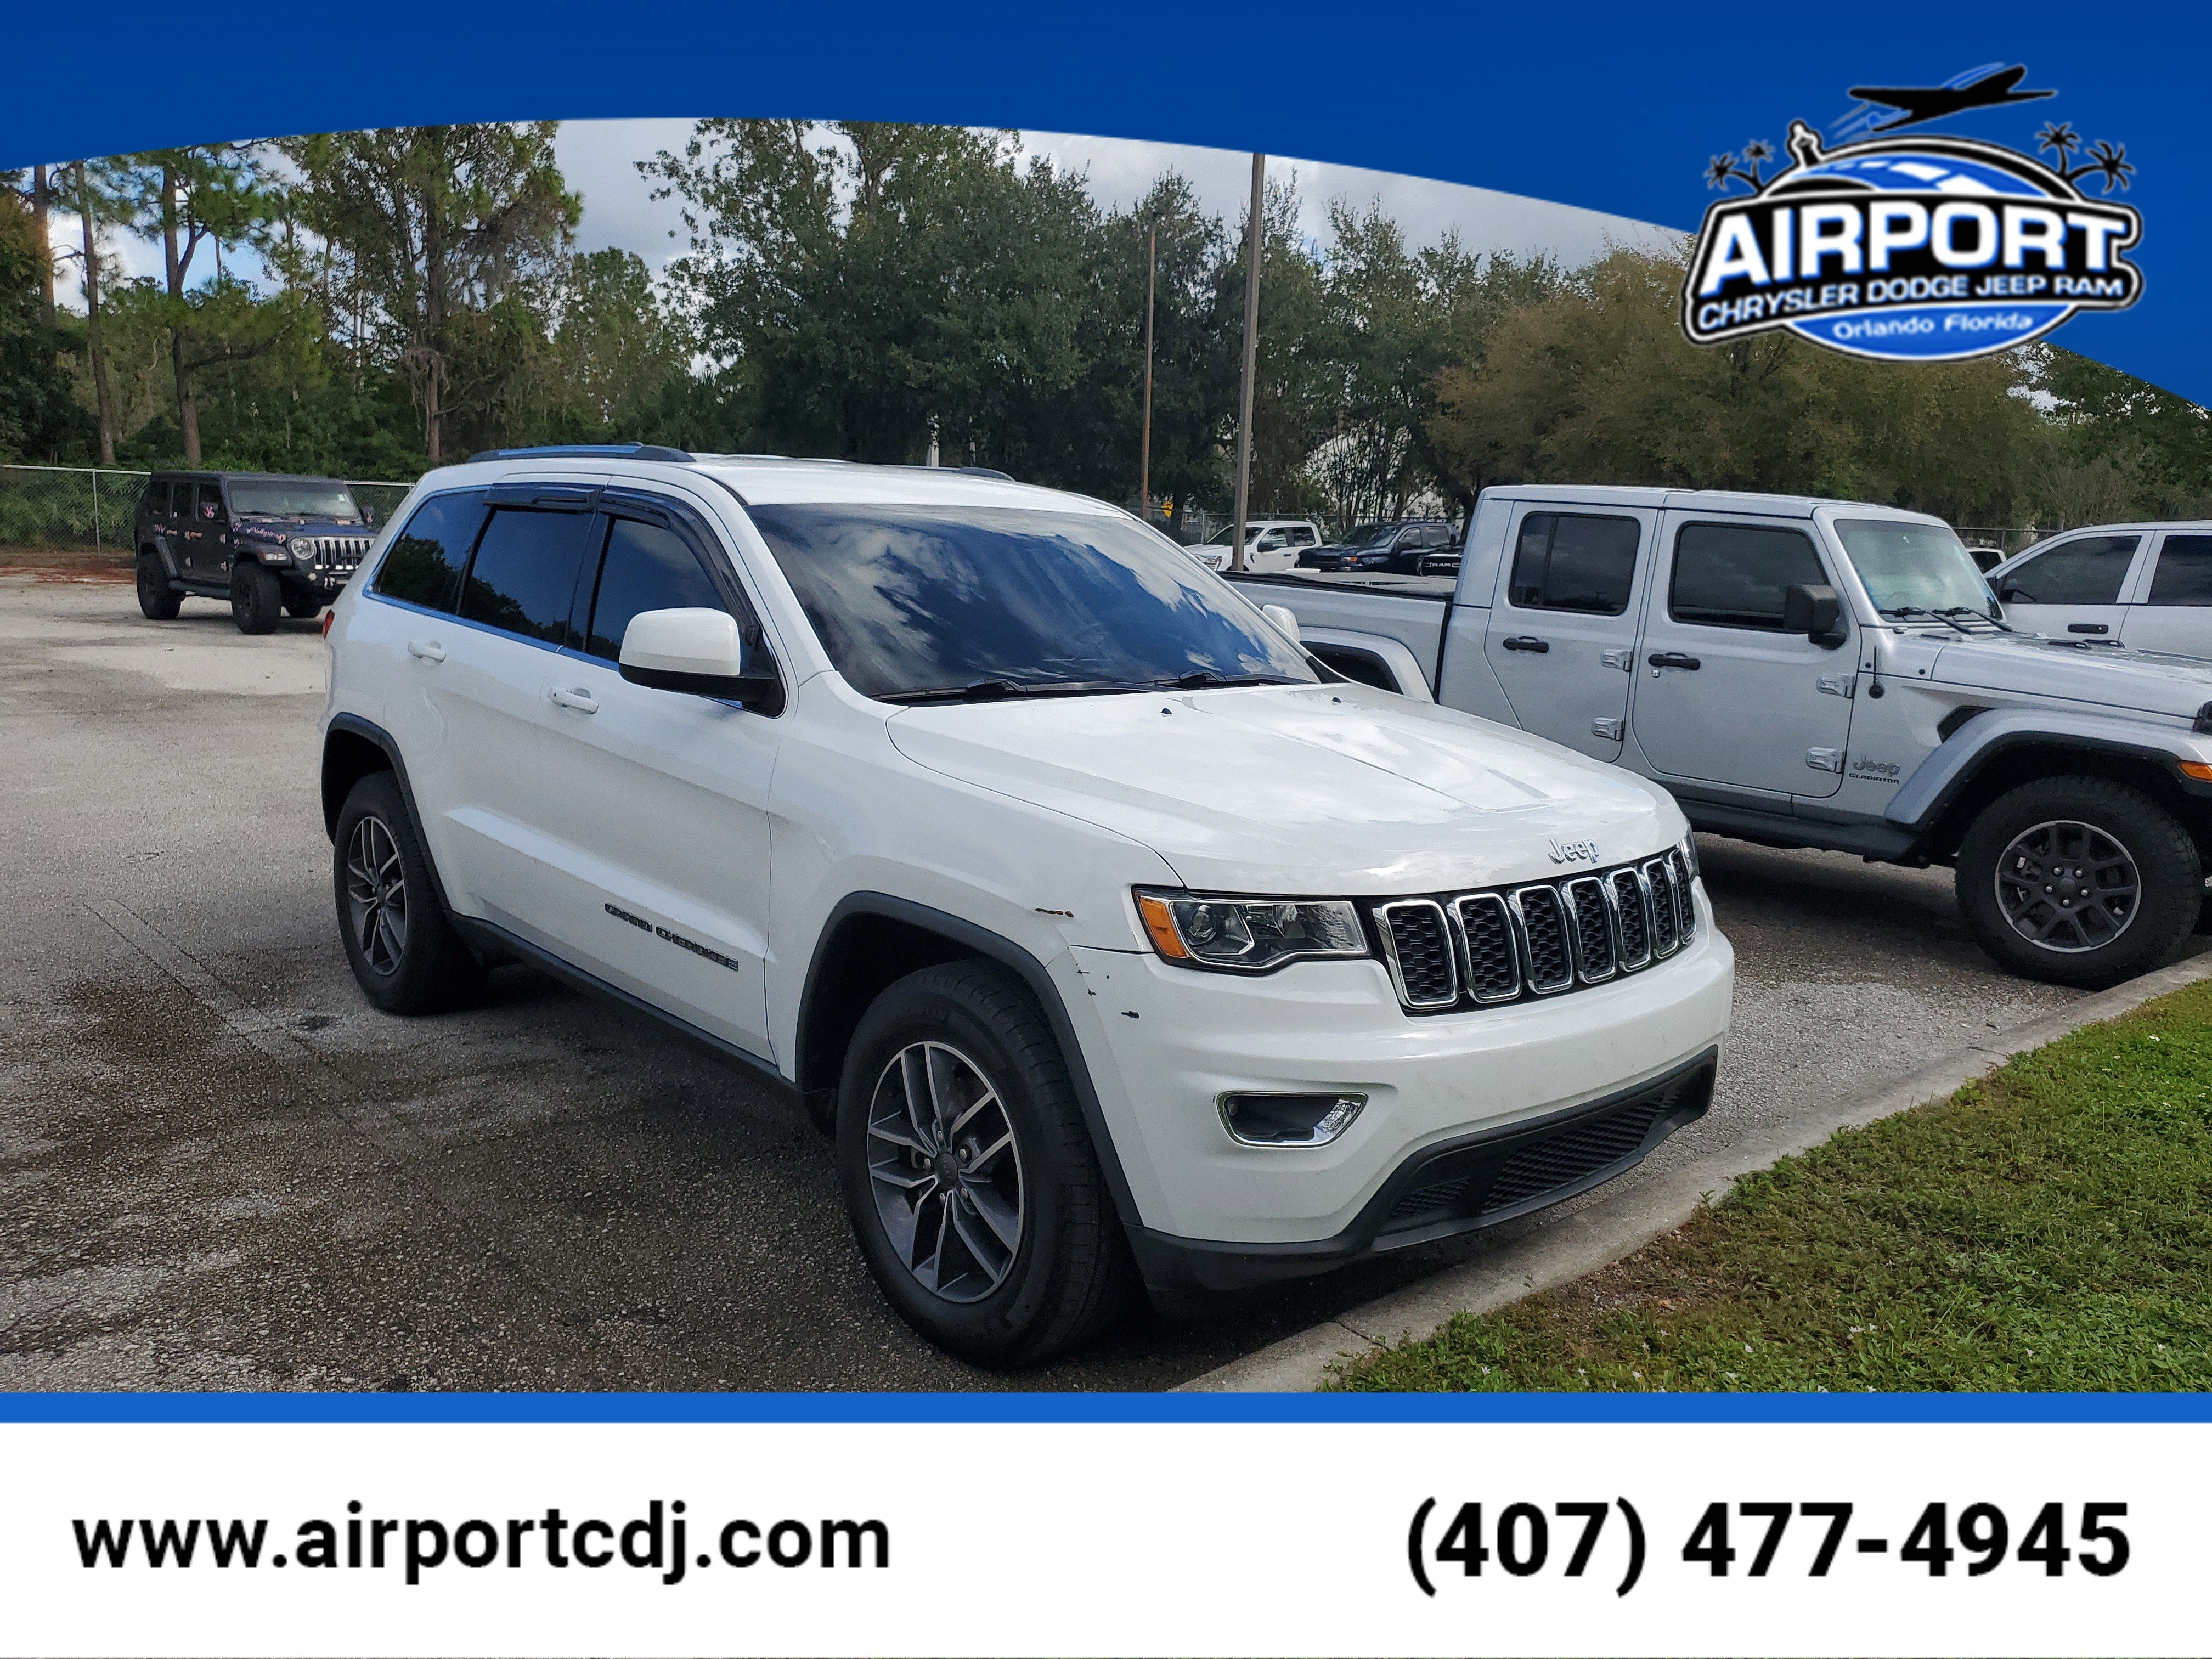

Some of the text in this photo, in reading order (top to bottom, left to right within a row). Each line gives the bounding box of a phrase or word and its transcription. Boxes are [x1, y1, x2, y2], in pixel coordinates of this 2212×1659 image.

[1853, 755, 1901, 777] Jeep
[1848, 772, 1900, 785] GLADIATOR
[1548, 838, 1600, 865] Jeep
